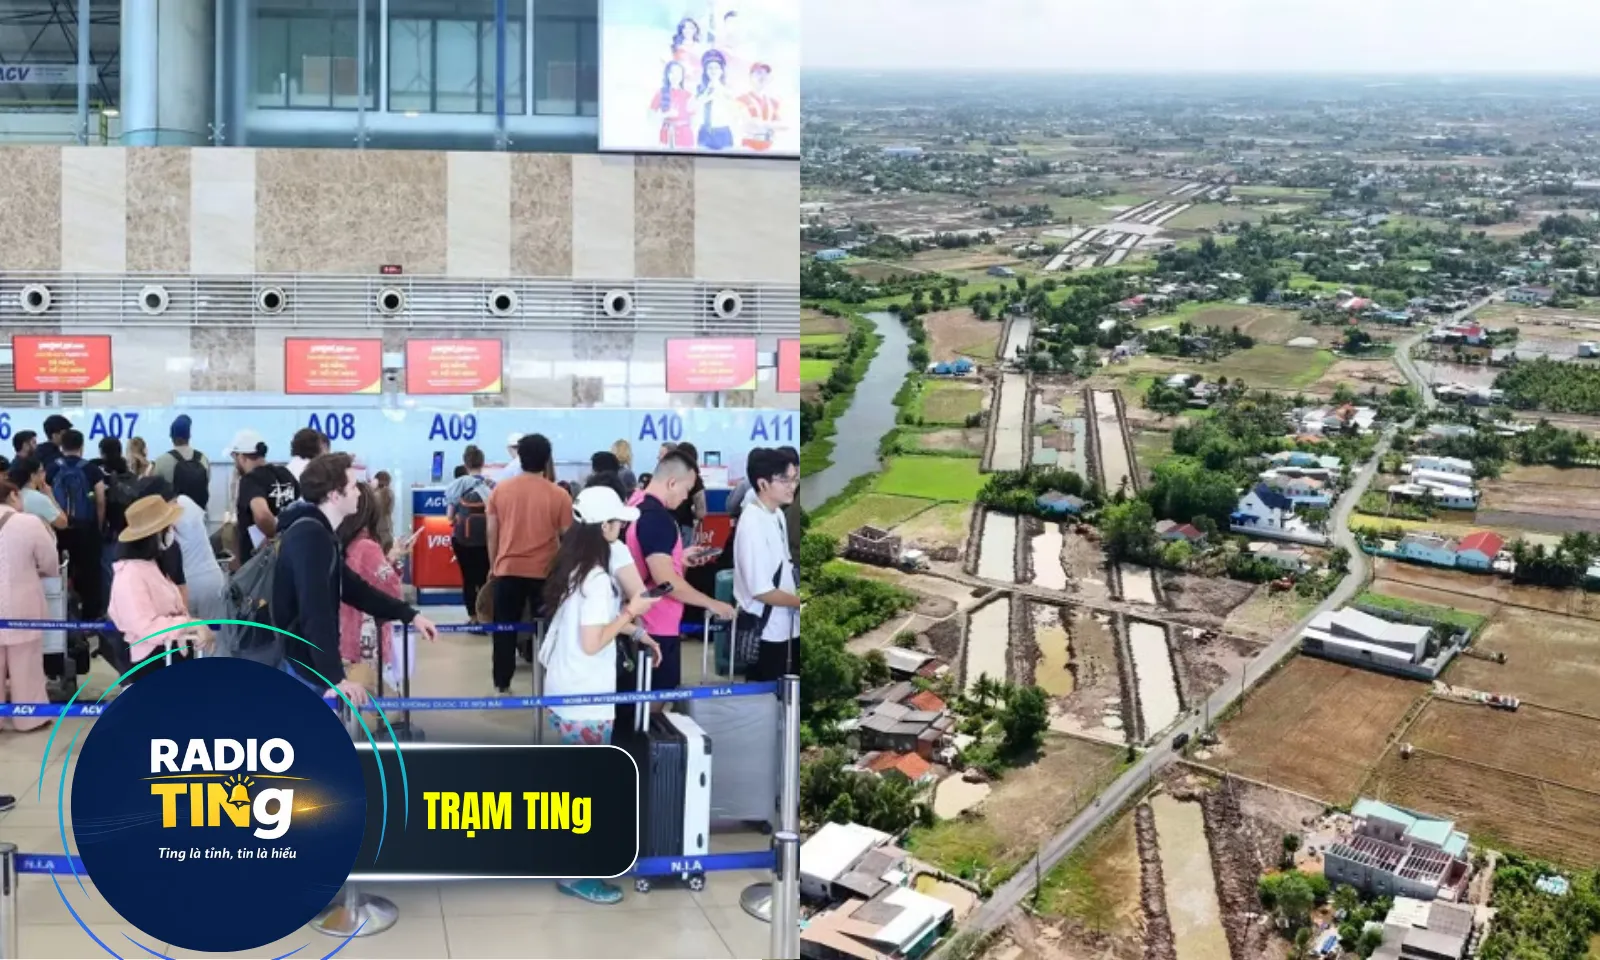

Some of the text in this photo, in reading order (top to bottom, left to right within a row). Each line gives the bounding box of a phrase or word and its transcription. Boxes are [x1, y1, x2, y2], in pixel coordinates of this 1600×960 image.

[89, 412, 139, 440] A07
[308, 412, 355, 440] A08
[429, 413, 477, 441] A09
[639, 413, 683, 441] A10
[750, 414, 793, 441] A11
[659, 690, 693, 700] AIRPORT
[12, 705, 36, 715] ACV
[80, 705, 104, 715] ACV
[671, 860, 703, 873] N.I.A
